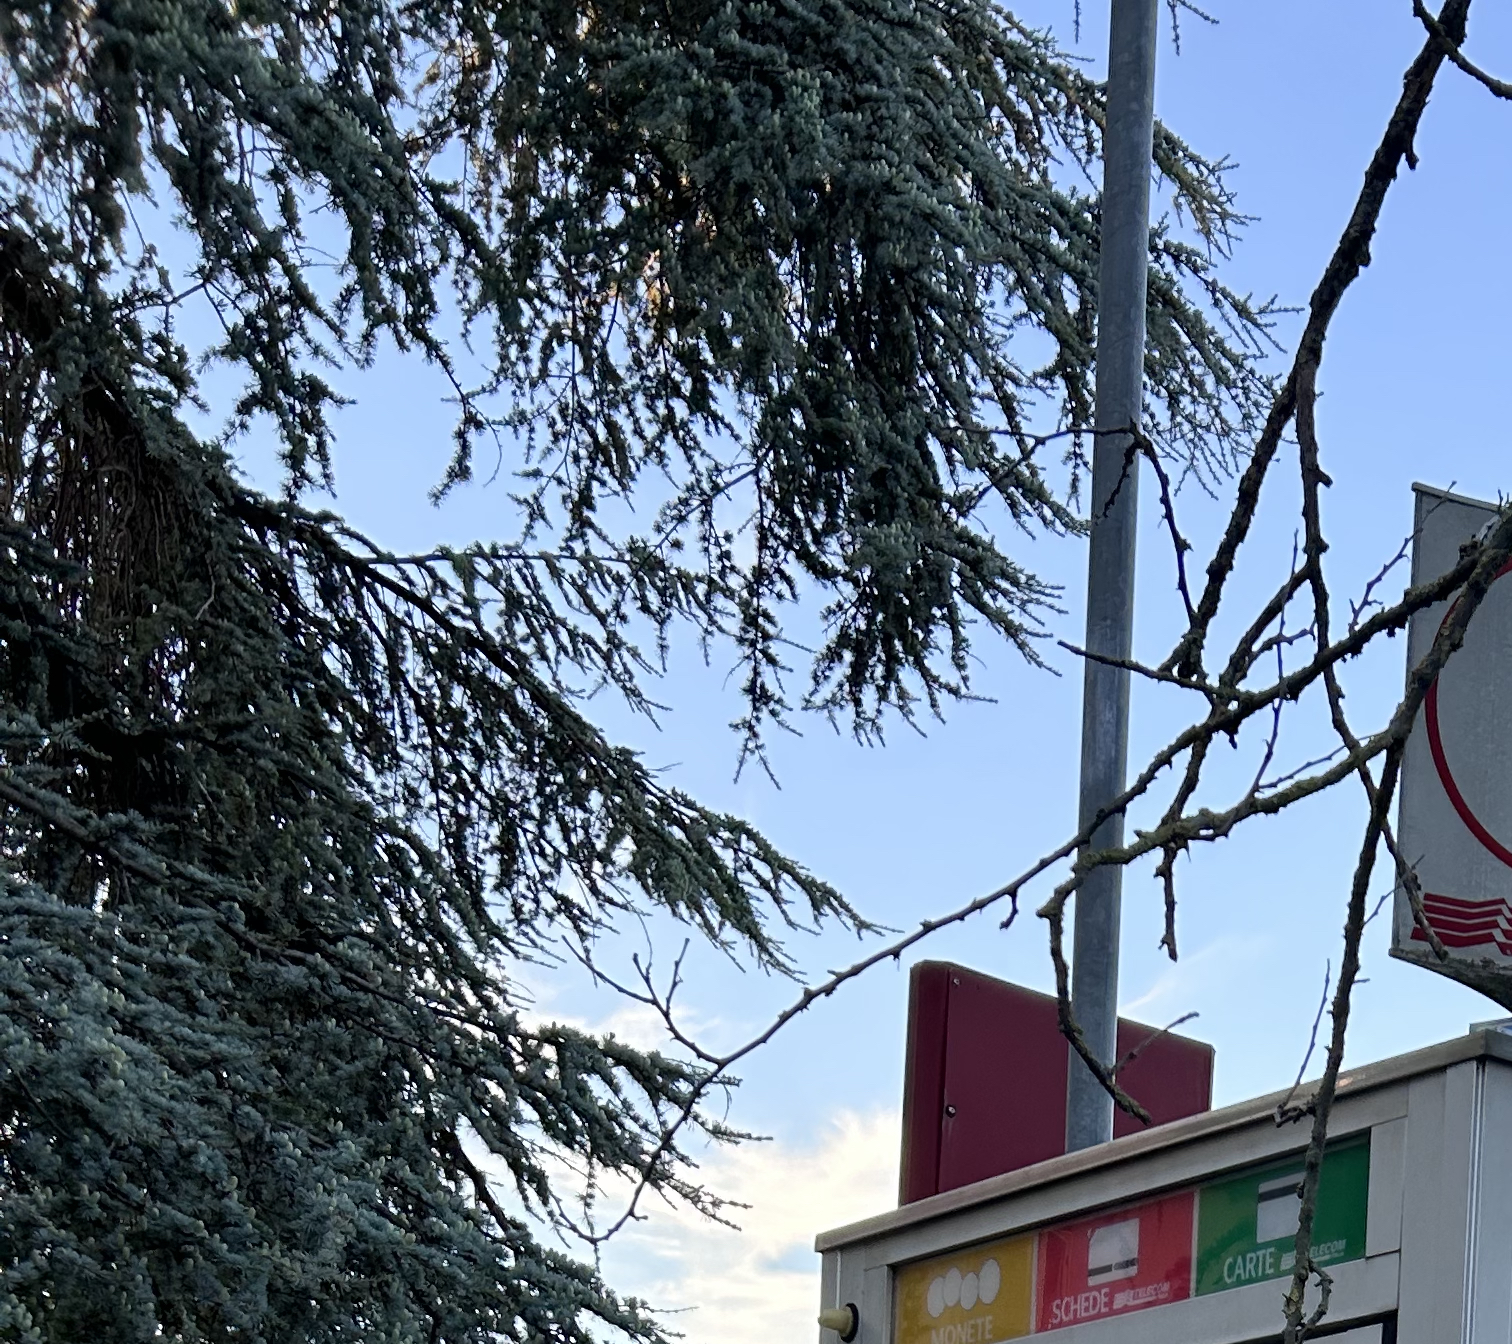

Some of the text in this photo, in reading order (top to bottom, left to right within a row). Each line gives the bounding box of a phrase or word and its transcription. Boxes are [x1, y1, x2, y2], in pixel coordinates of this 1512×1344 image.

[1223, 1239, 1347, 1284] CARTE ELECOM
[1052, 1288, 1110, 1323] SCHEDE
